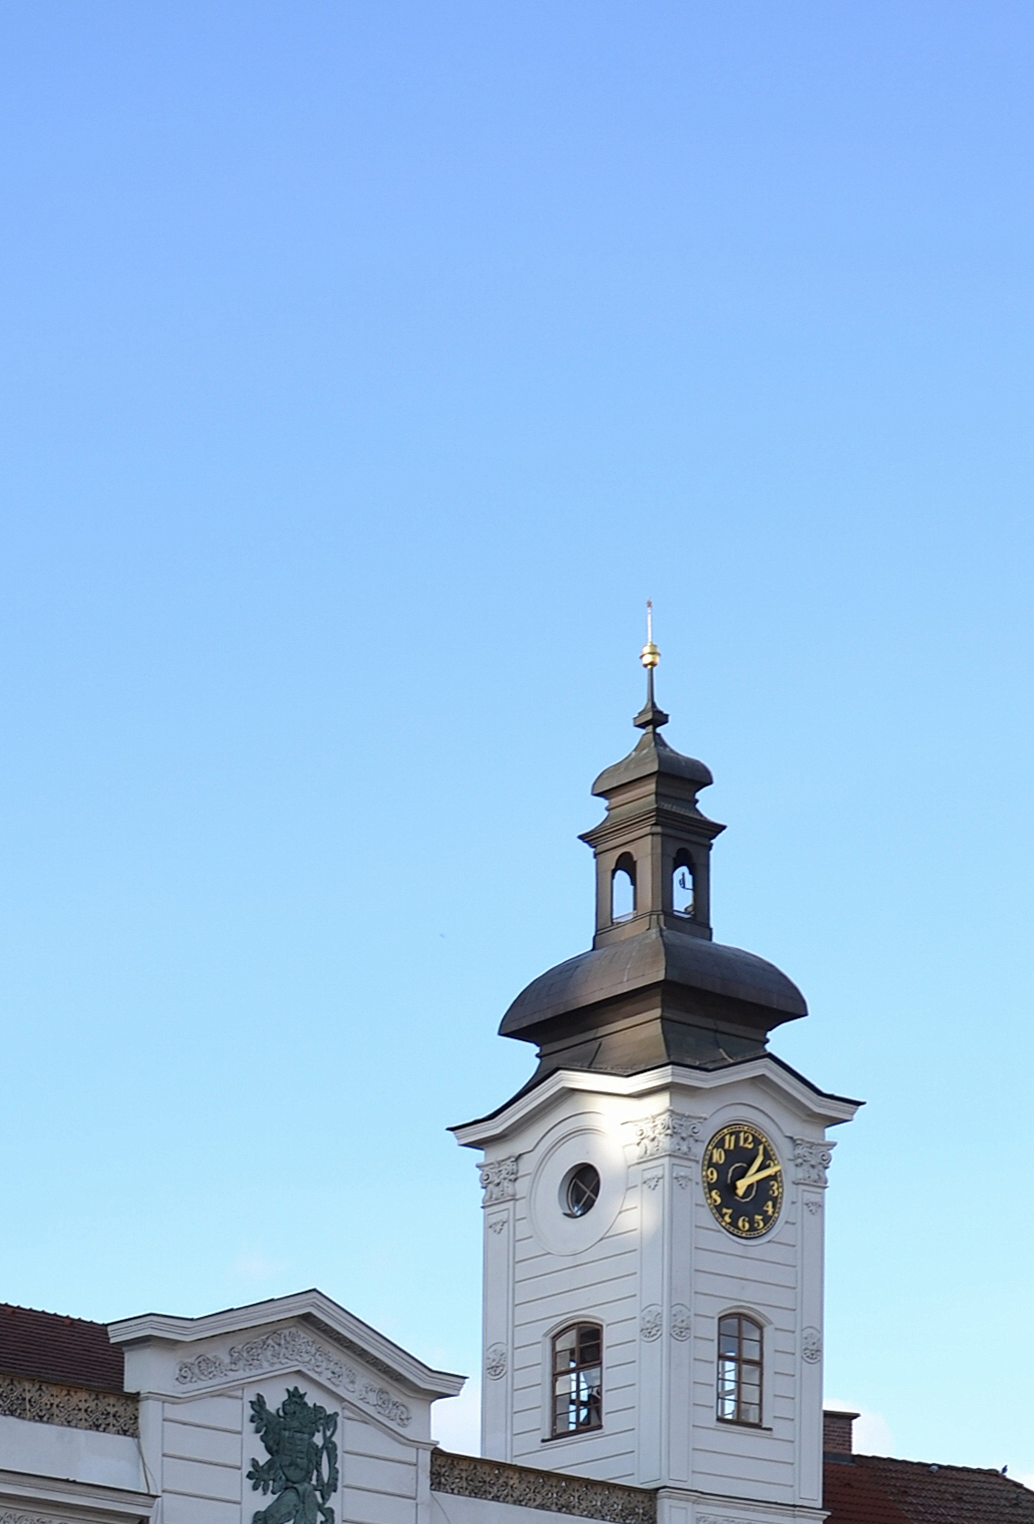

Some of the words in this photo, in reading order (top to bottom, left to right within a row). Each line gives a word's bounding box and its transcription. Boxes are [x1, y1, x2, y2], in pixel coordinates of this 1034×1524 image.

[724, 1134, 736, 1150] 11
[739, 1131, 754, 1149] 12
[712, 1148, 725, 1165] 10
[707, 1167, 717, 1184] 9
[769, 1181, 779, 1197] 3
[711, 1189, 722, 1206] 8
[722, 1208, 733, 1224] 7
[763, 1201, 774, 1216] 4
[738, 1216, 749, 1231] 6
[754, 1214, 764, 1229] 5
